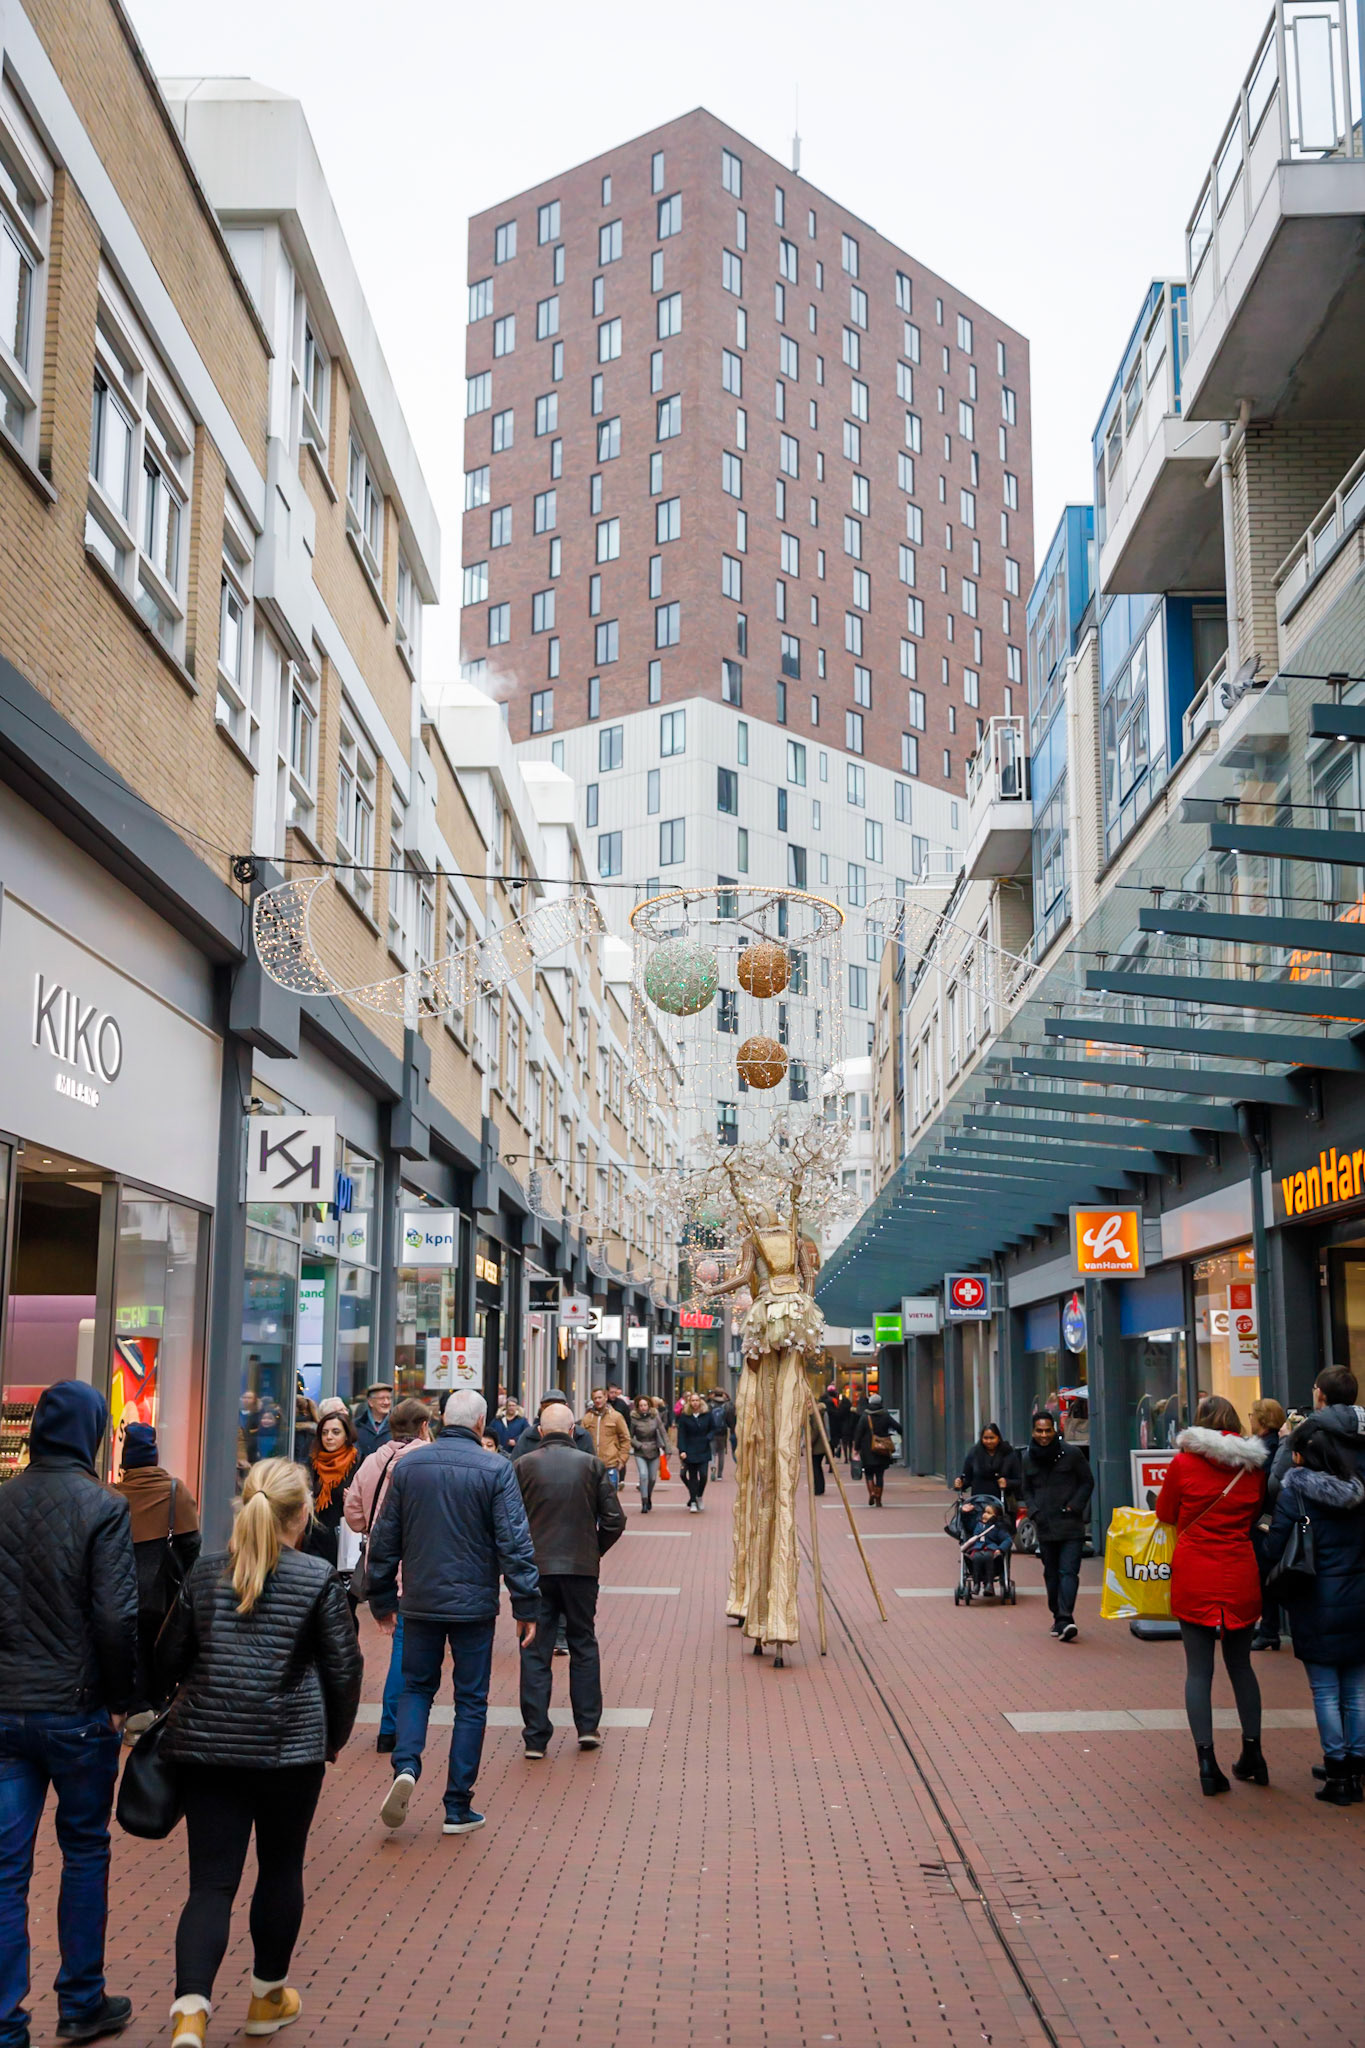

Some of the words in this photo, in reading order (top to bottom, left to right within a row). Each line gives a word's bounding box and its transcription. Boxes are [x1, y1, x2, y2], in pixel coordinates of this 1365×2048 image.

[32, 972, 123, 1084] KIKO
[333, 1169, 353, 1221] pn
[1281, 1146, 1365, 1217] vanHar
[425, 1233, 453, 1246] kpn
[1084, 1262, 1133, 1270] vanHaren
[908, 1312, 934, 1320] VIETHA
[1124, 1555, 1172, 1582] Inte
